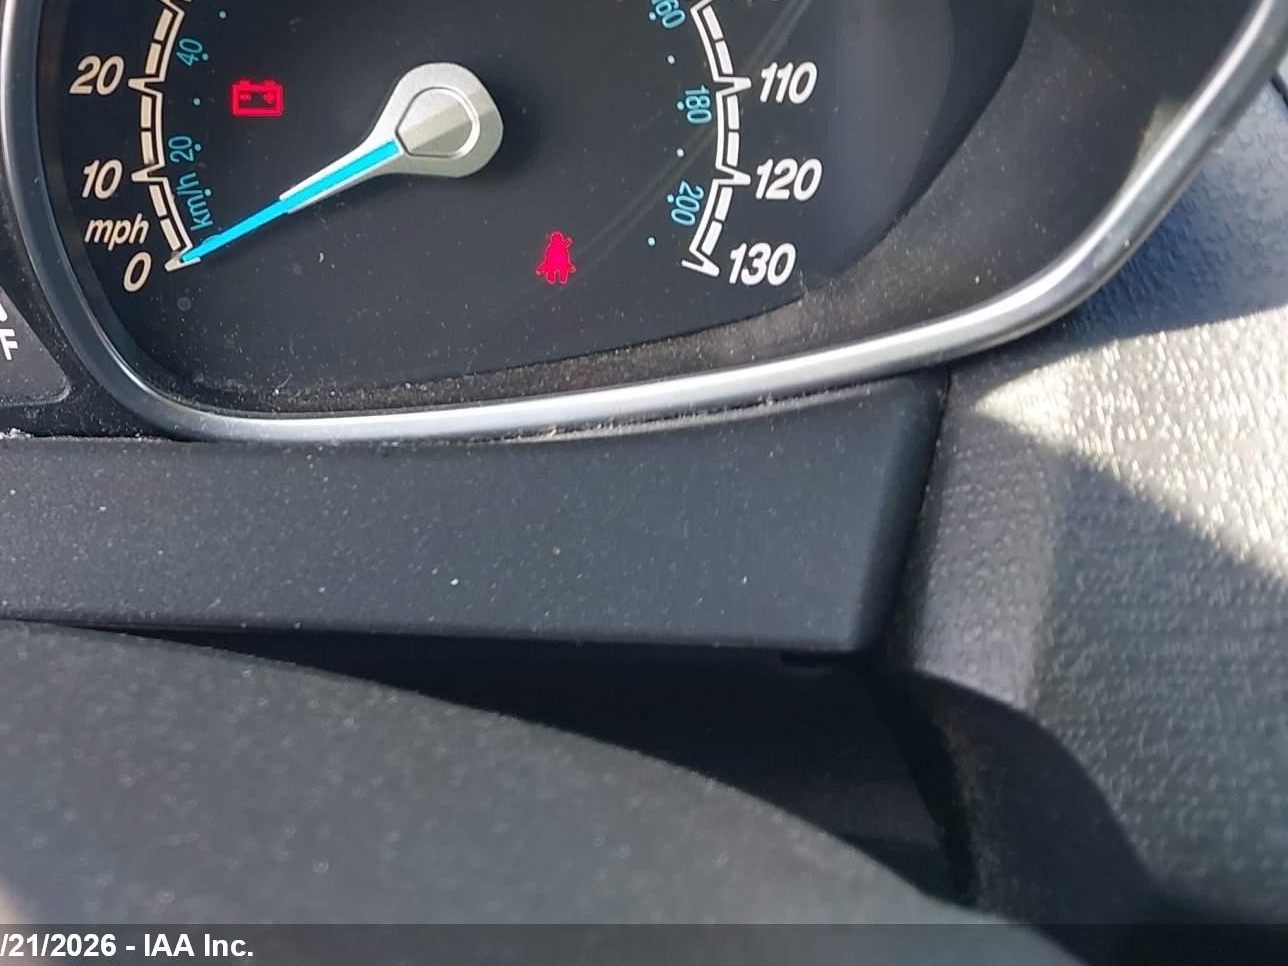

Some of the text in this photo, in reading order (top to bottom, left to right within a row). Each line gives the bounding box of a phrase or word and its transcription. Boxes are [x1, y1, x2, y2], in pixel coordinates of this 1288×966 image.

[178, 38, 203, 66] 40
[69, 56, 124, 95] 20
[760, 63, 817, 103] 110
[684, 86, 712, 124] 180
[170, 136, 194, 164] 20
[83, 161, 121, 199] 10
[756, 160, 822, 200] 120
[179, 173, 212, 229] km/h
[672, 180, 704, 226] 200
[84, 218, 149, 249] mph
[123, 255, 150, 292] 0
[730, 244, 796, 284] 130
